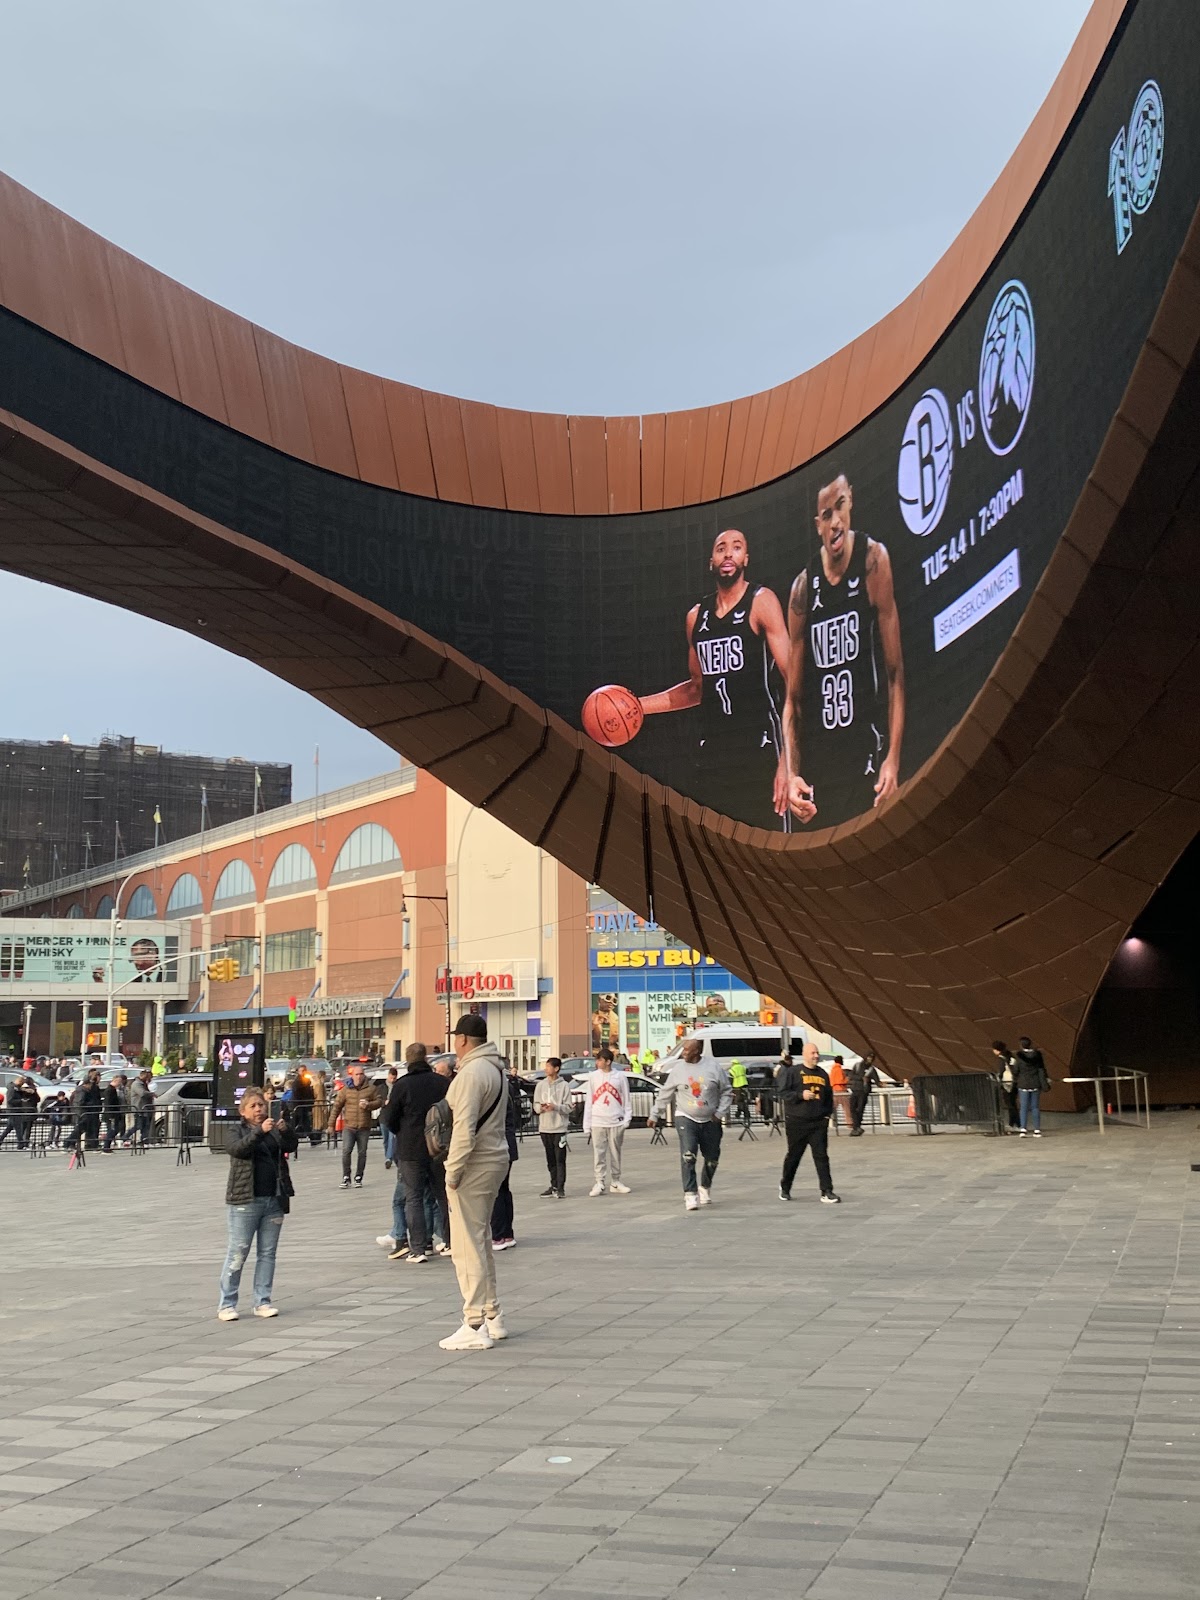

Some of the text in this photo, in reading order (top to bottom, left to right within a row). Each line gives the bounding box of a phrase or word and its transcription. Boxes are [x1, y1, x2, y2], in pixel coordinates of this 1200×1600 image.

[956, 389, 977, 449] VS
[922, 543, 949, 586] TUE
[949, 528, 967, 563] 4.4
[978, 468, 1024, 537] 7:30PM
[938, 564, 1015, 639] SEATGEEK.COM/NETS
[811, 610, 860, 669] NETS
[696, 635, 744, 675] NETS
[715, 677, 732, 715] 1
[821, 669, 854, 730] 33
[594, 912, 640, 933] DAVE
[26, 936, 73, 946] MERCER
[86, 936, 127, 946] PRINCE
[26, 948, 74, 957] WHISKY
[596, 950, 661, 967] BEST
[648, 993, 692, 1002] MERCER
[657, 1003, 689, 1012] PRIC
[648, 1013, 674, 1022] WHI
[603, 1095, 610, 1107] 4
